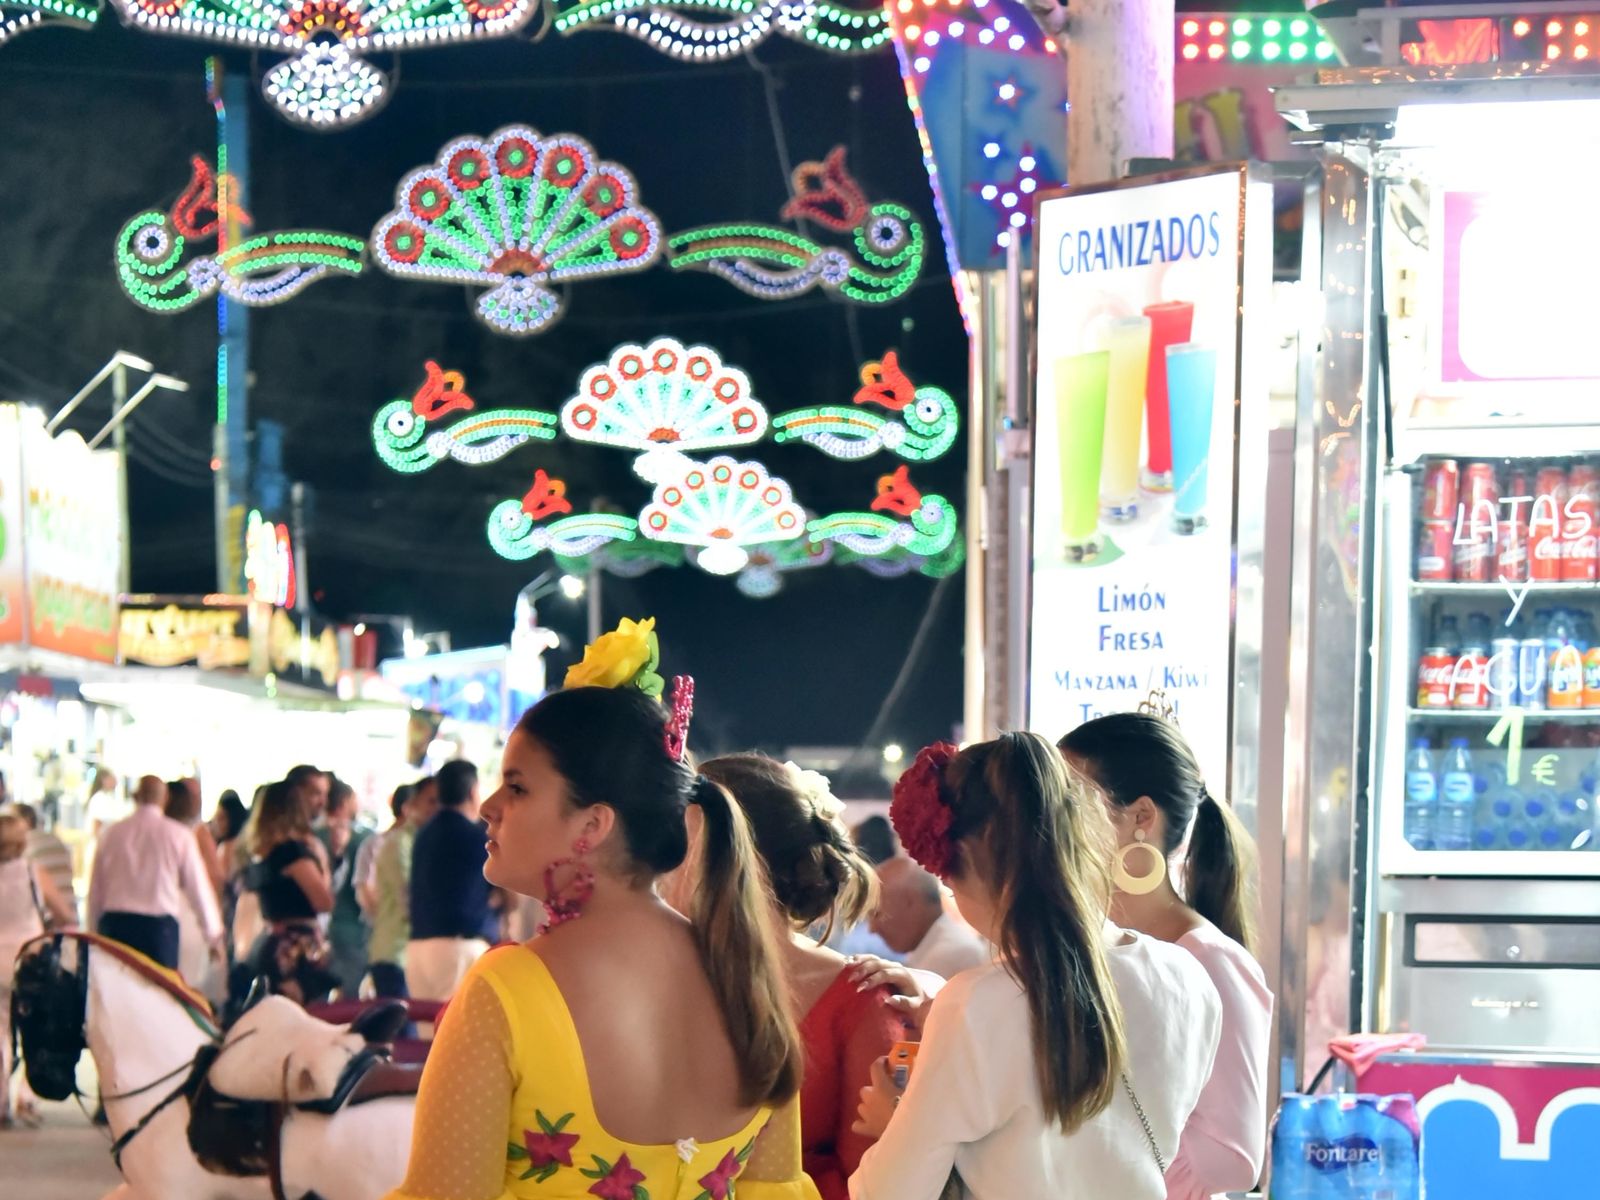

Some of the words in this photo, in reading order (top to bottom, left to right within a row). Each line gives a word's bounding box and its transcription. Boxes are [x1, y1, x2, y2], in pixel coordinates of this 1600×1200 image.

[1059, 211, 1220, 276] GRANIZADOS
[1453, 494, 1592, 545] LATAS
[1499, 574, 1535, 628] Y
[1099, 624, 1164, 651] FRESA
[1055, 670, 1138, 691] MANZANA
[1448, 645, 1583, 701] AGUA
[1531, 754, 1560, 786] €
